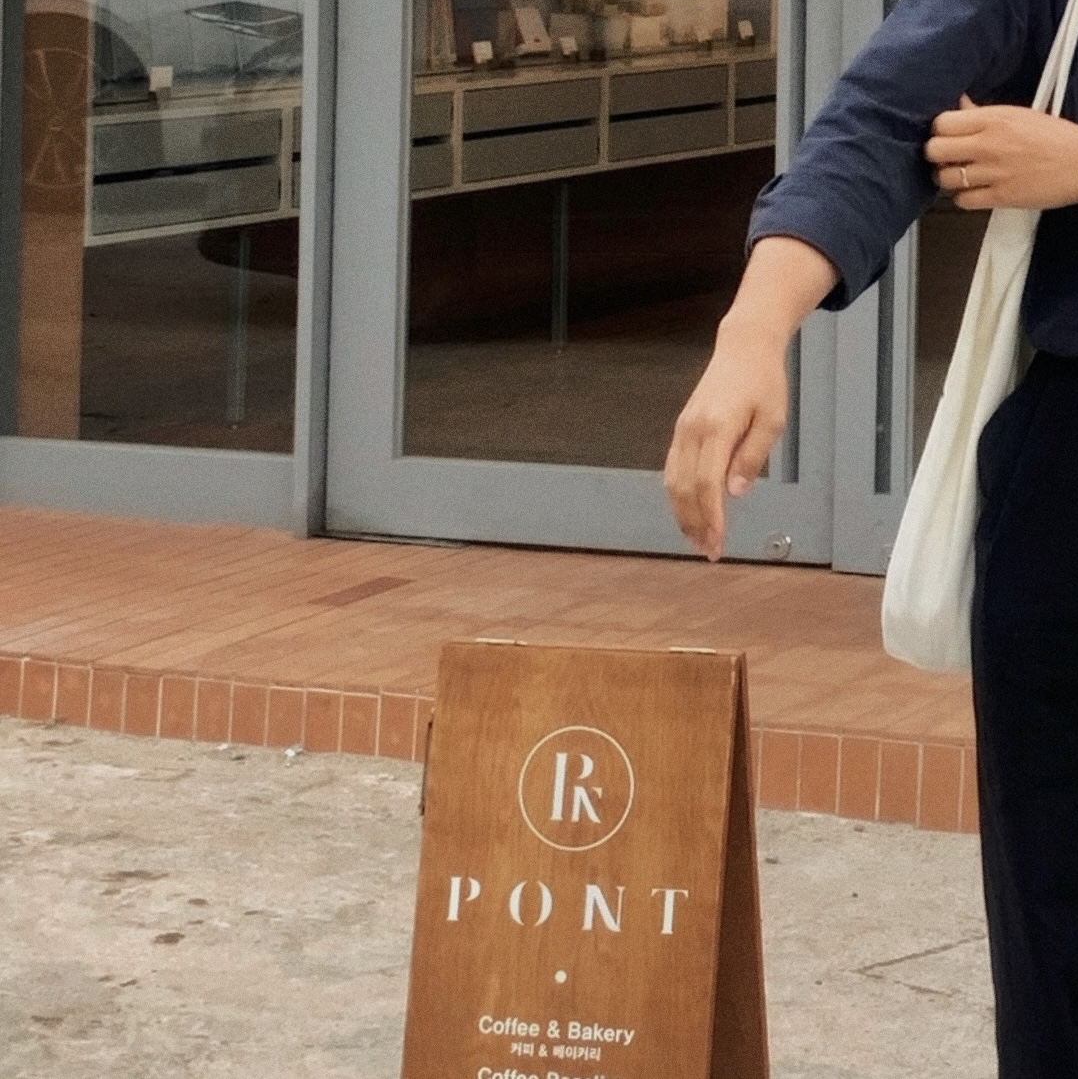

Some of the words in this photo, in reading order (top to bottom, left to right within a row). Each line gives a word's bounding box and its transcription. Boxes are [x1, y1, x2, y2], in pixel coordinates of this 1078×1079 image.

[446, 875, 689, 935] PONT
[478, 1014, 540, 1037] Coffee
[547, 1019, 561, 1039] &
[567, 1020, 636, 1046] Bakery
[510, 1041, 535, 1057] 커피
[538, 1043, 548, 1058] &
[552, 1044, 602, 1061] 베이커리
